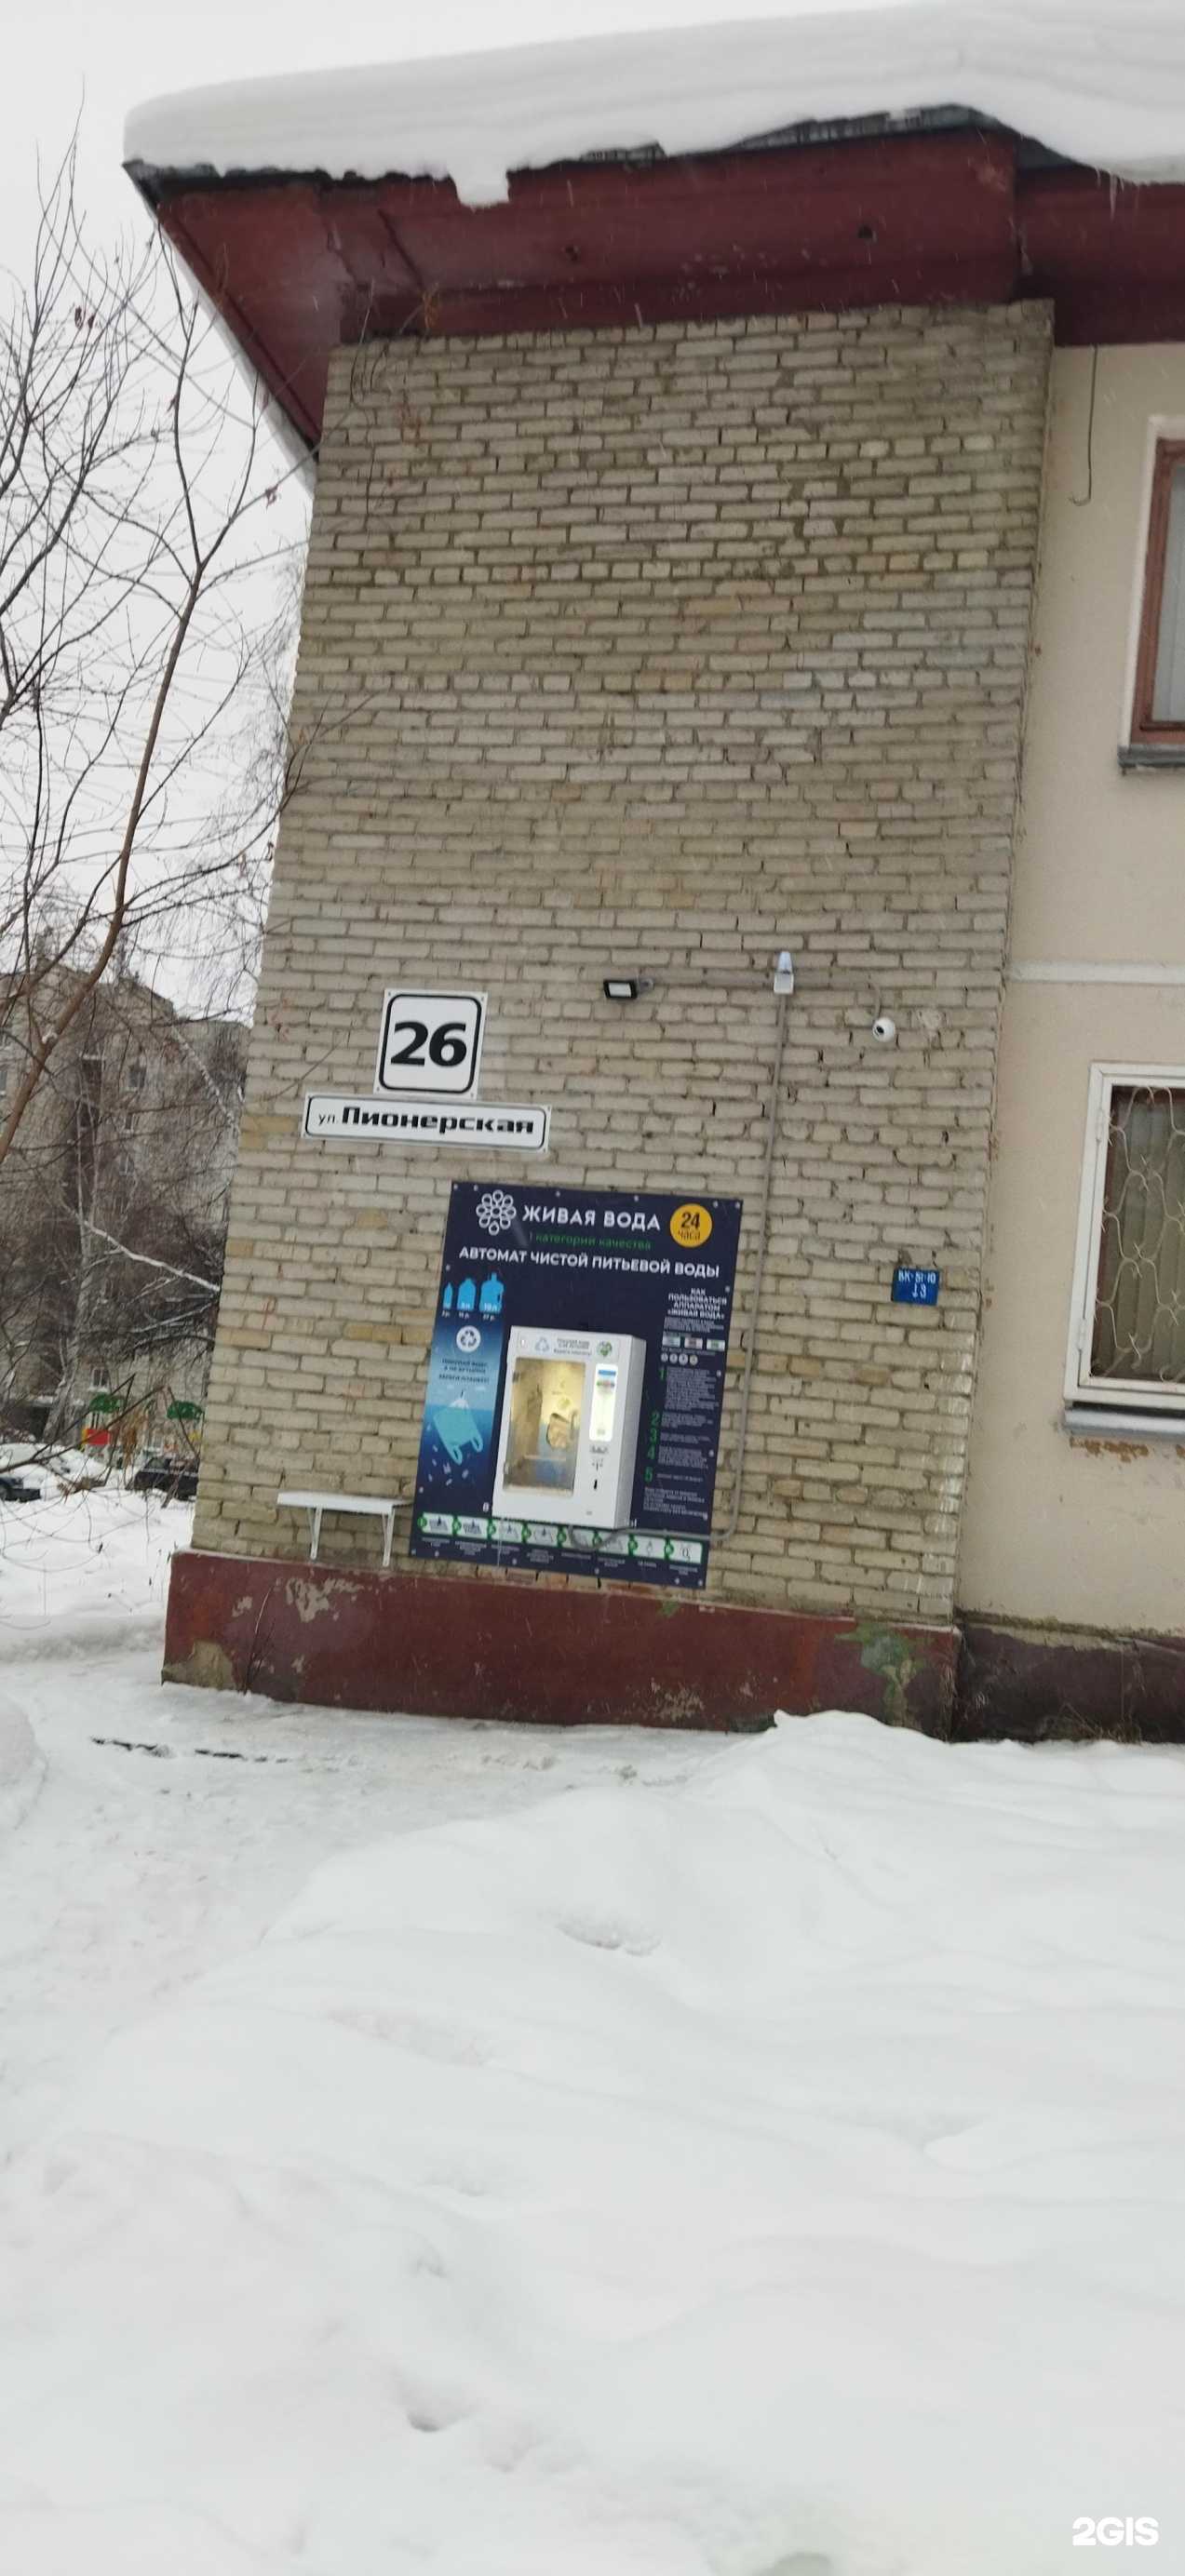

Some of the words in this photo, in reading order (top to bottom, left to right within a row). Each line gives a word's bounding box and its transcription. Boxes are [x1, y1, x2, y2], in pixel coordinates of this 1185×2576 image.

[390, 1021, 468, 1067] 26
[341, 1106, 534, 1134] Пионерская
[522, 1204, 597, 1227] ЖИВАЯ
[603, 1210, 661, 1232] ВОДА
[680, 1211, 701, 1230] 24
[678, 1229, 701, 1242] часа
[599, 1237, 652, 1251] качества
[459, 1245, 528, 1264] АВТОМАТ
[530, 1249, 588, 1268] ЧИСТОЙ
[591, 1254, 671, 1275] ПИТЬЕВОЙ
[674, 1261, 720, 1279] ВОДЫ
[691, 1287, 707, 1296] КАК
[667, 1293, 727, 1306] ПОЛЬЗОВАТЬСЯ
[673, 1301, 720, 1313] АППАРАТОМ
[651, 1412, 661, 1427] 2
[649, 1429, 658, 1442] 3
